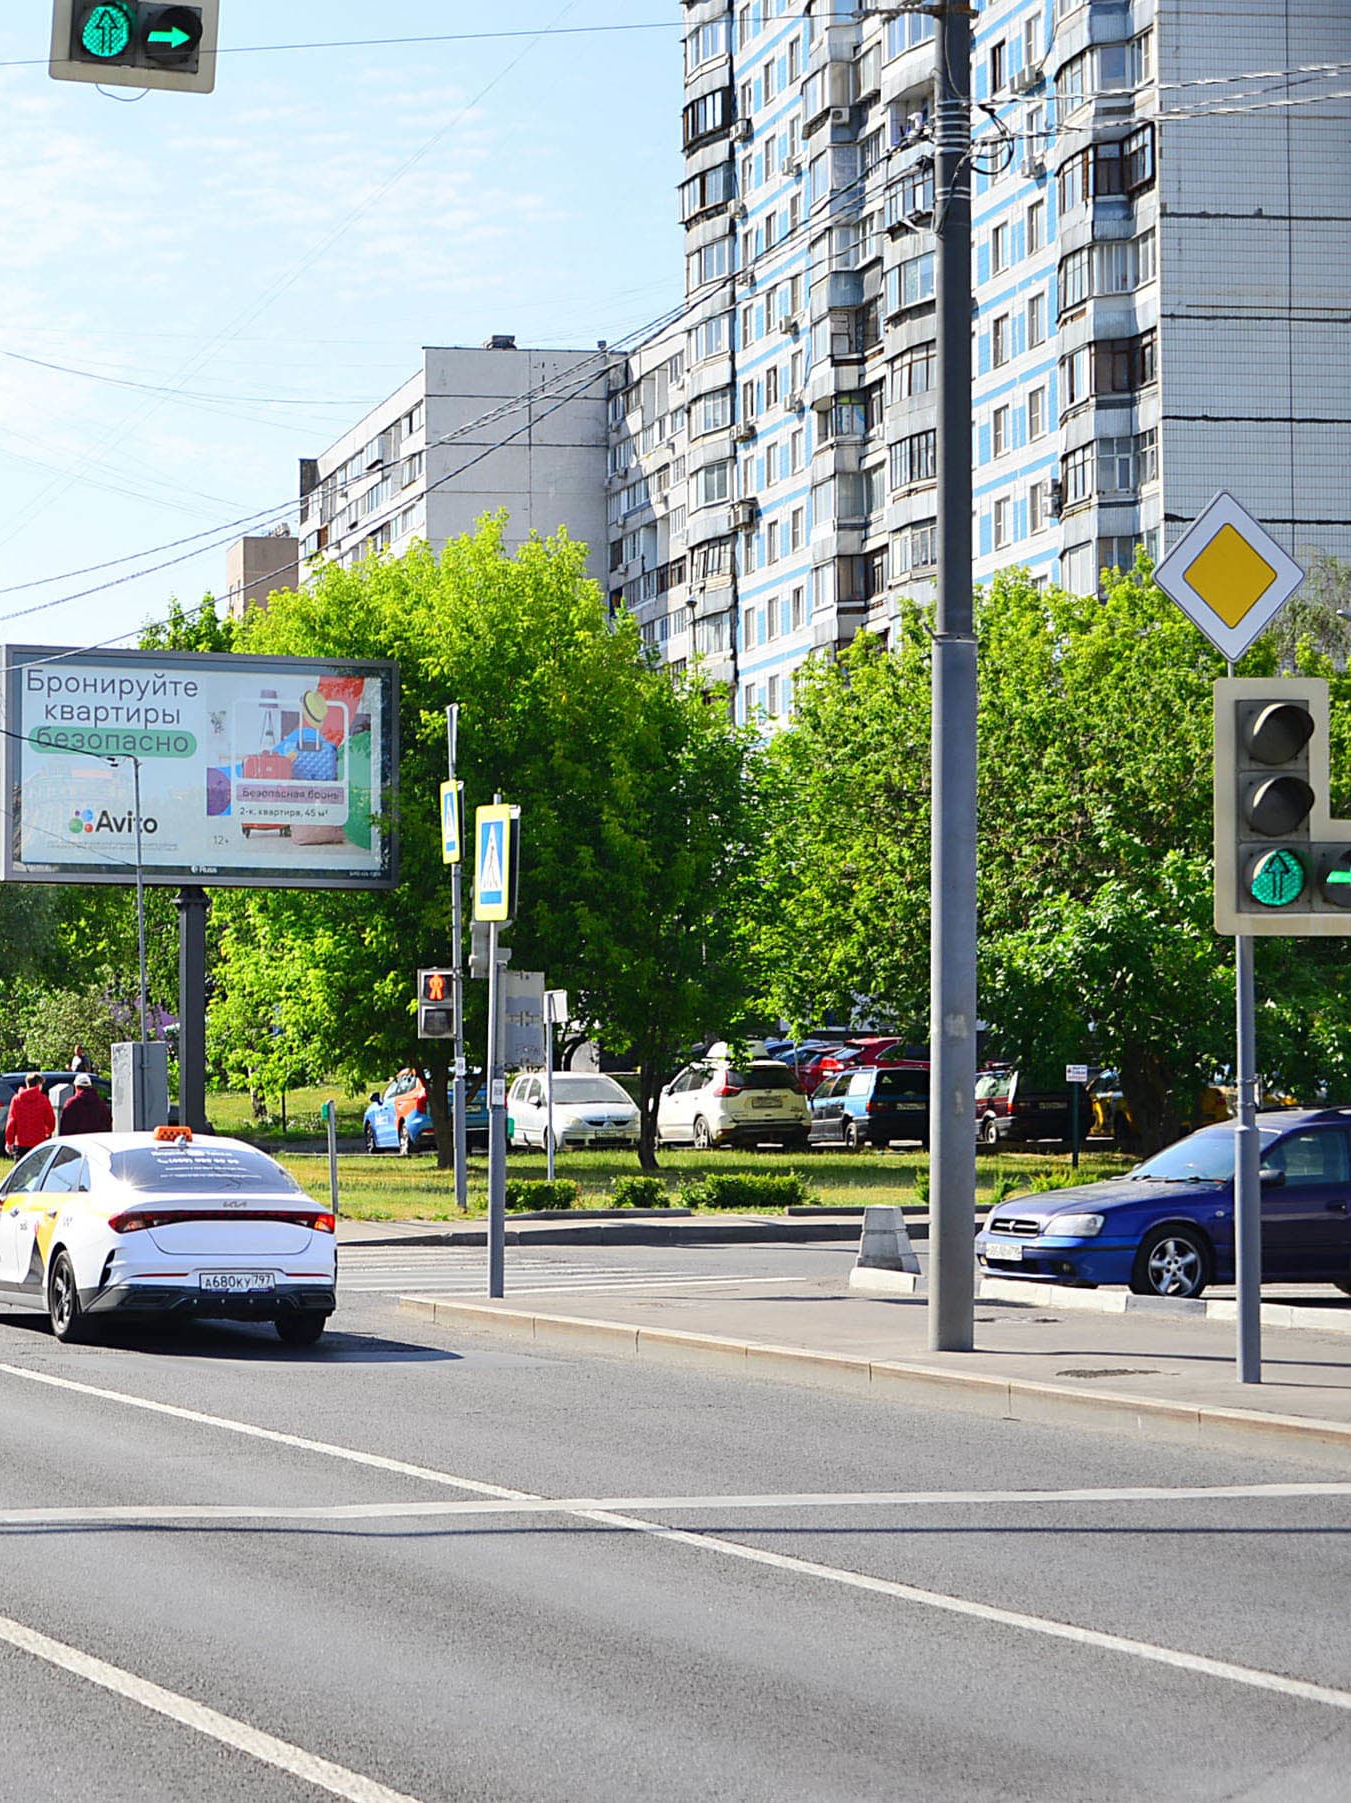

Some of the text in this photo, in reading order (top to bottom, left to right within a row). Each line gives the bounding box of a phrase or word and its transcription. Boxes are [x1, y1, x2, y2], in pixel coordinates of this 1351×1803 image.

[26, 669, 199, 701] Бронируйте
[44, 703, 181, 730] квартиры
[36, 726, 189, 753] безопасно
[242, 787, 340, 802] Безопасная бронь
[305, 808, 317, 817] 45
[212, 834, 230, 846] 12+
[205, 1274, 271, 1288] А680КУ 797
